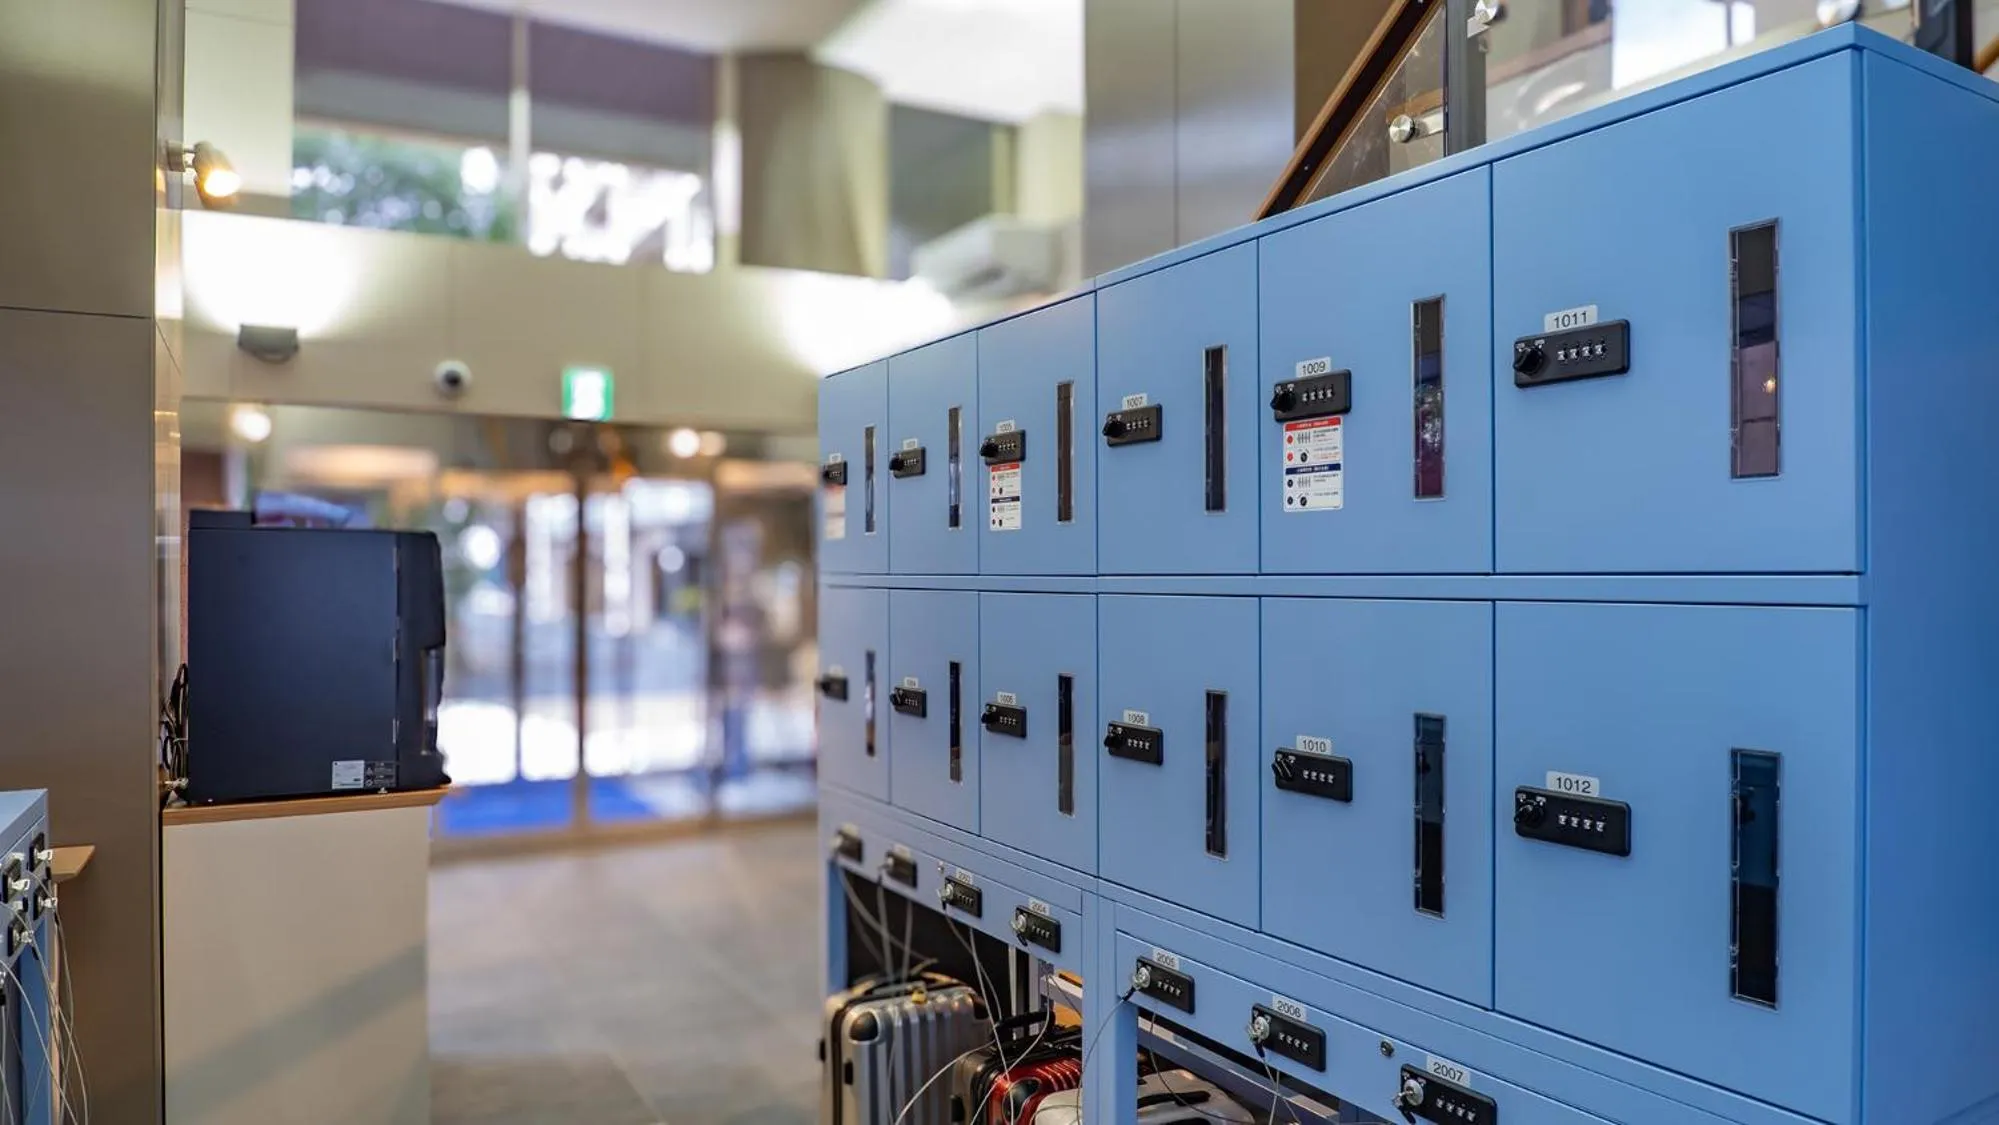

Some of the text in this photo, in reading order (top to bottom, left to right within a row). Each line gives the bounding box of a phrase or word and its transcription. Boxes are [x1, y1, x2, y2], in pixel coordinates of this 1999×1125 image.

[1554, 310, 1588, 329] 1011
[1302, 361, 1326, 377] 1009
[1303, 739, 1327, 753] 1010
[1556, 777, 1592, 794] 1012
[1277, 1000, 1302, 1018] 2006
[1433, 1061, 1464, 1082] 2007
